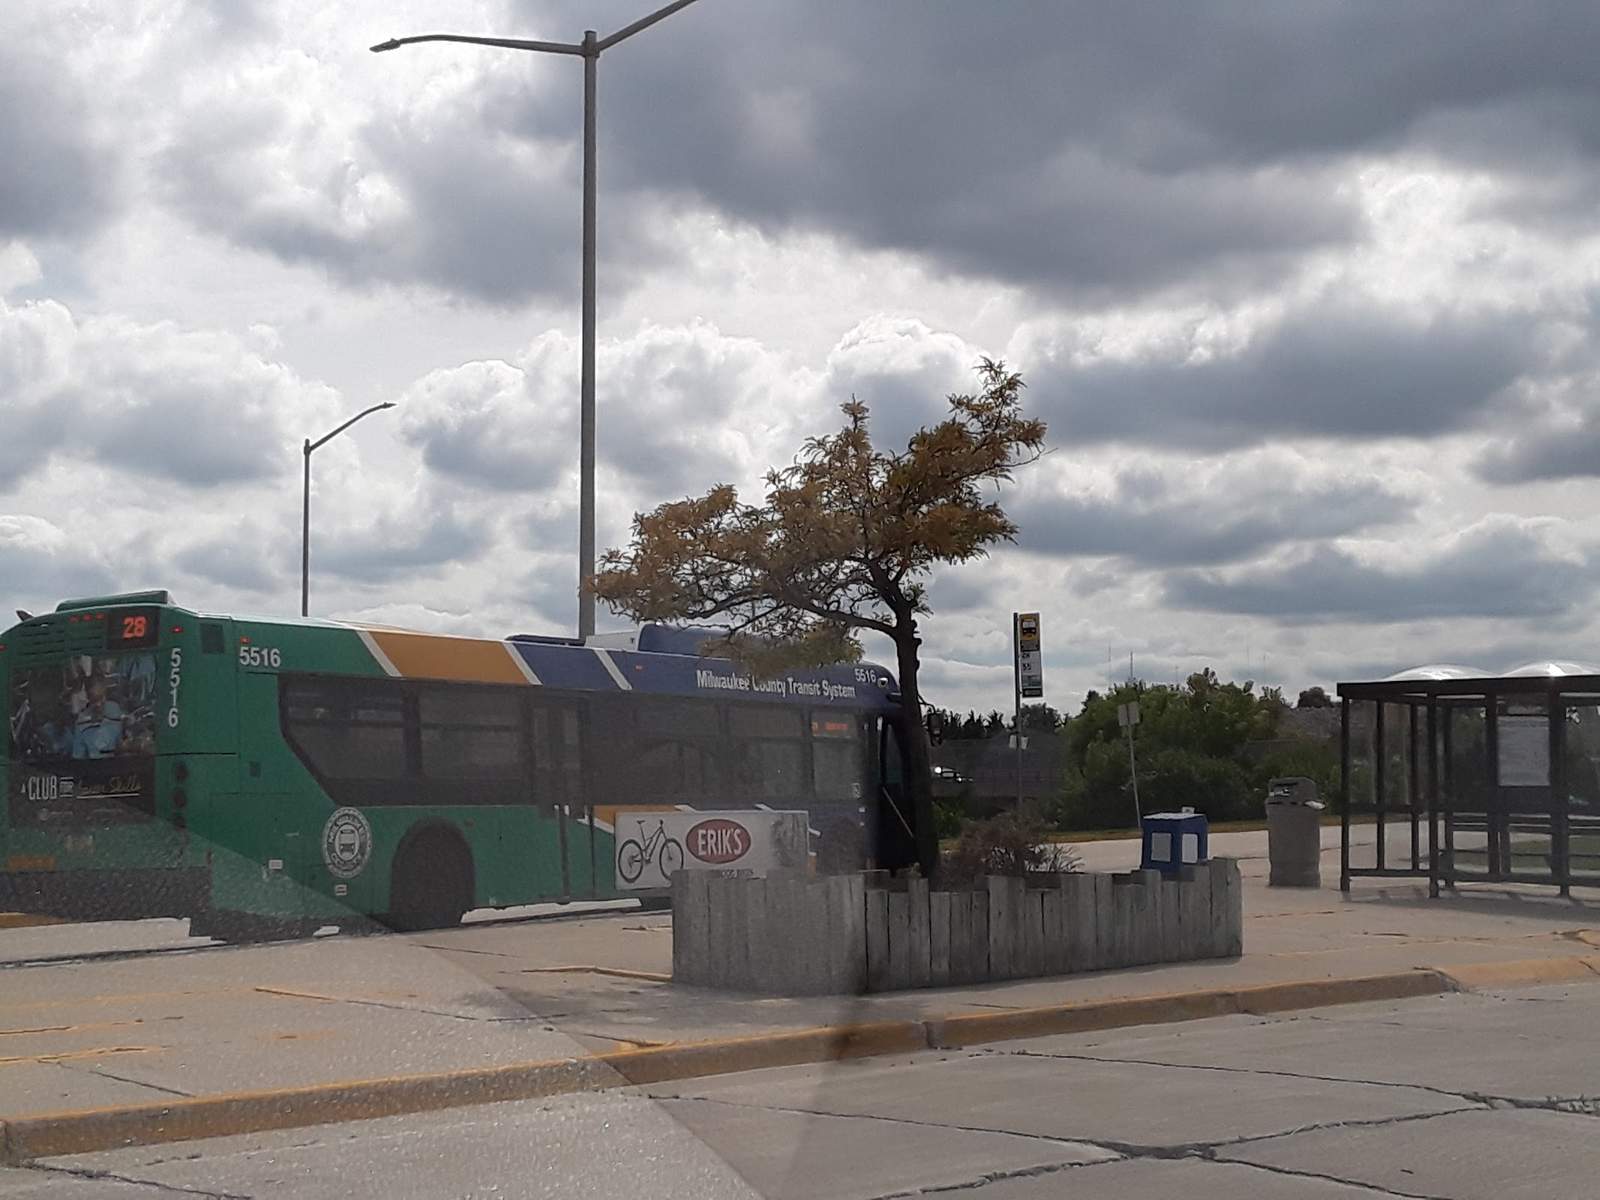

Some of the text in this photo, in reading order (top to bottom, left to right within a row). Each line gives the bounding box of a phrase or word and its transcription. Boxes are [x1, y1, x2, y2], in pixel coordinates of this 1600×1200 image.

[122, 616, 146, 638] 28
[239, 647, 281, 667] 5516
[168, 648, 181, 727] 5516
[696, 670, 750, 690] Milwaukee
[787, 677, 820, 695] Transit
[822, 680, 856, 700] System
[855, 668, 876, 682] 5516
[28, 775, 57, 800] CLUB
[697, 828, 743, 856] ERIK'S
